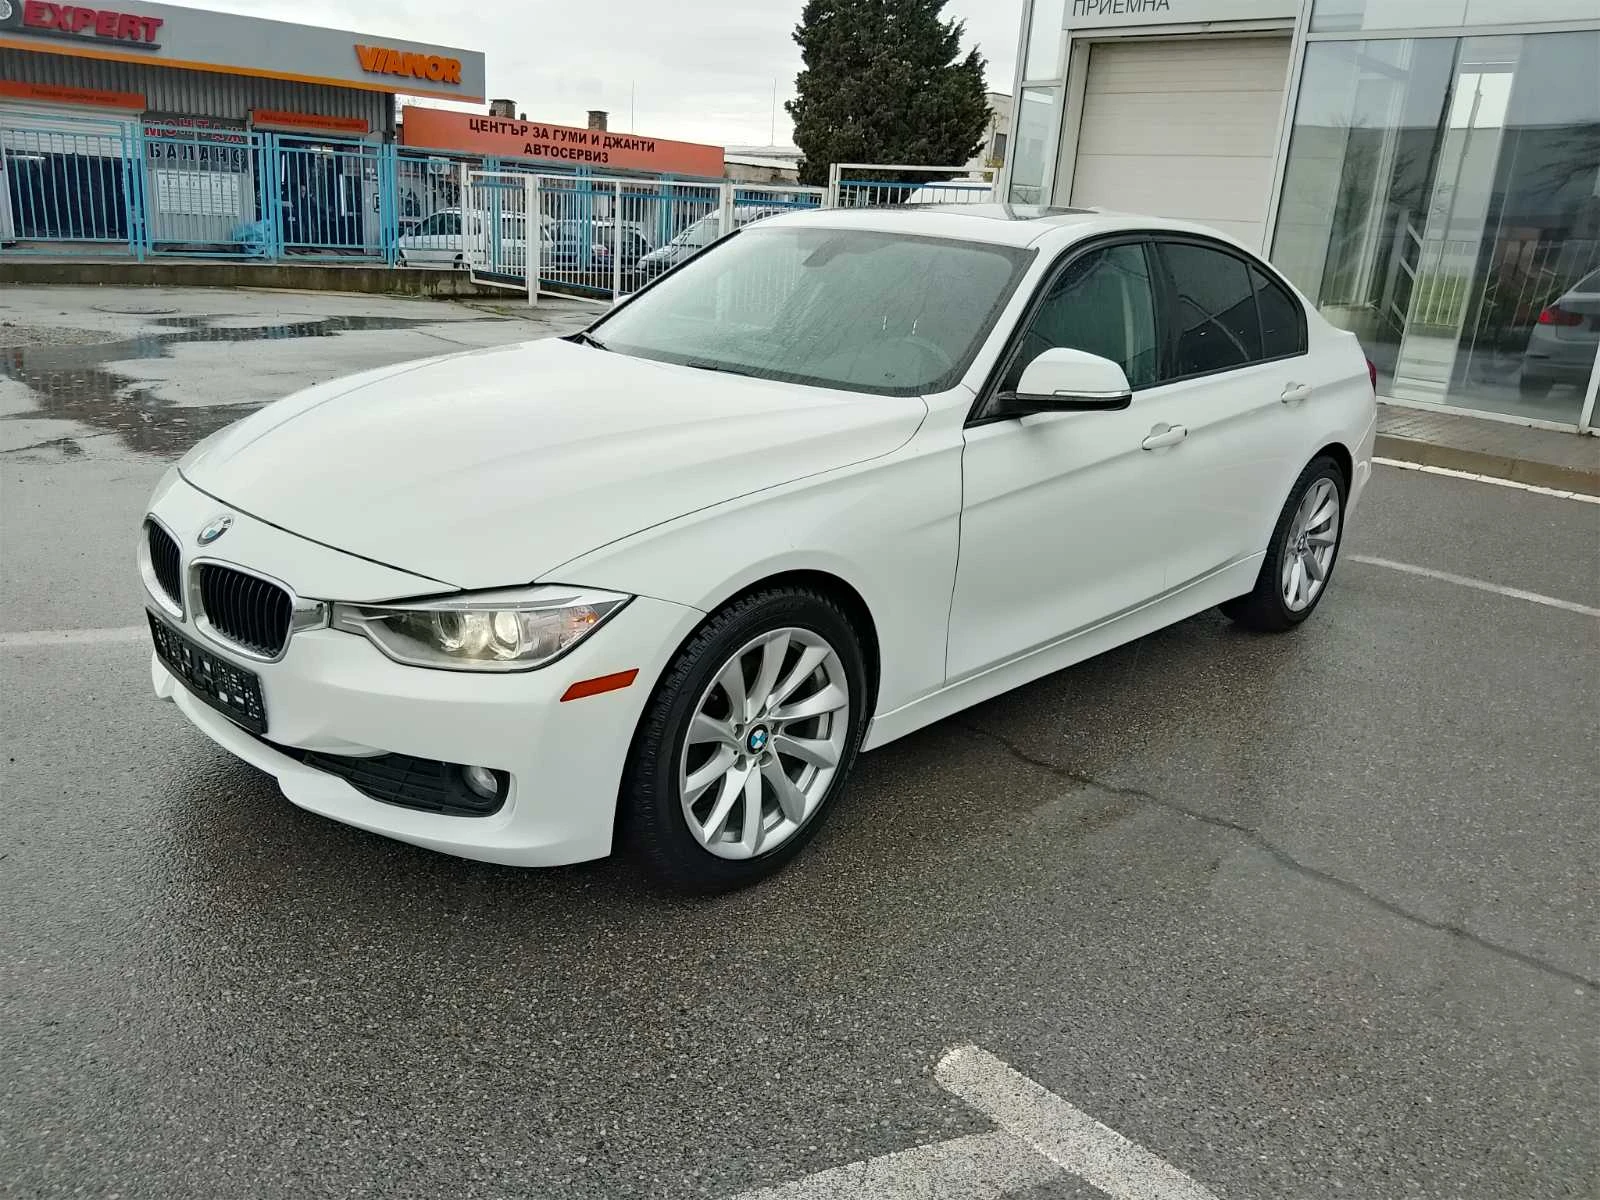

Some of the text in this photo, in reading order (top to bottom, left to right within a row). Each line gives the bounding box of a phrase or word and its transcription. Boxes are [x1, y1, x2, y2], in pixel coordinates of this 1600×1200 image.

[24, 0, 164, 42] EXPERT
[1072, 0, 1170, 16] ПРИЕМНА
[353, 44, 462, 84] VIANOR
[469, 118, 655, 152] ЦЕНТЪР ЗА ГУМИ И ДЖАНТИ
[523, 143, 609, 163] АВТОСЕРВИЗ
